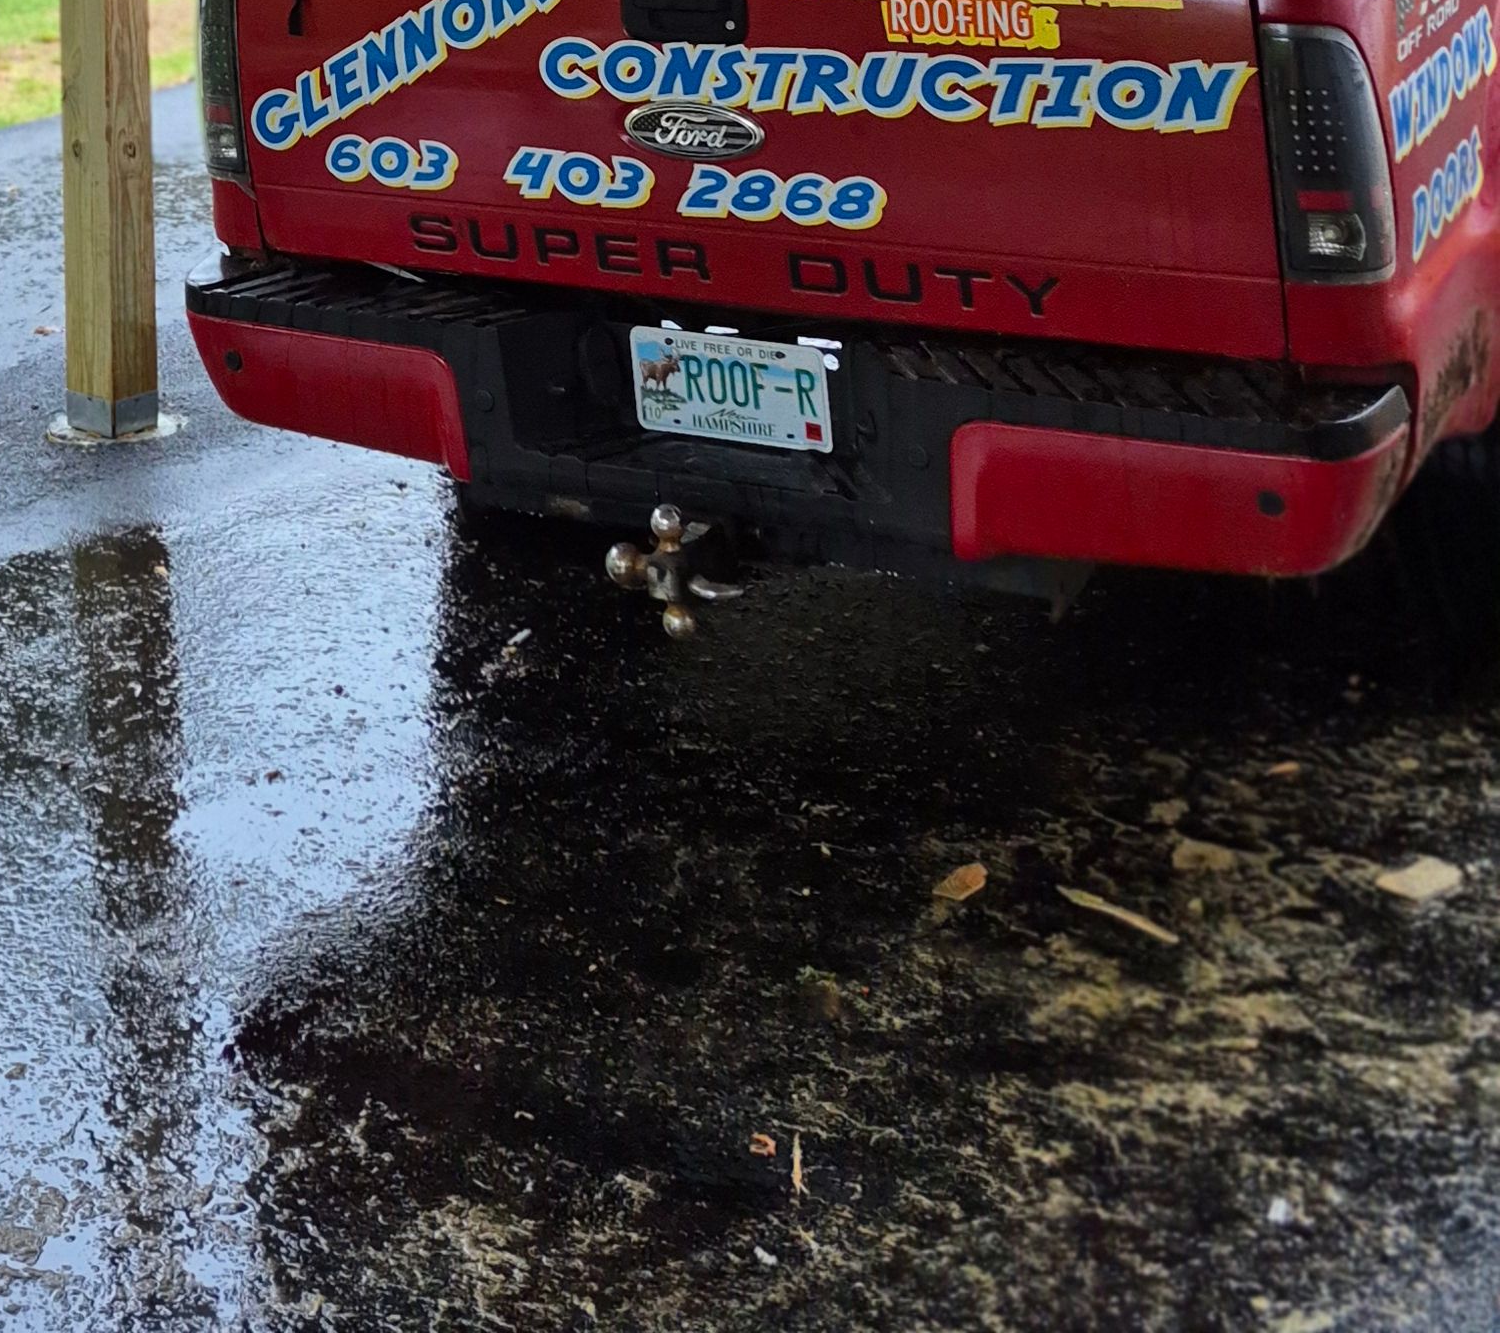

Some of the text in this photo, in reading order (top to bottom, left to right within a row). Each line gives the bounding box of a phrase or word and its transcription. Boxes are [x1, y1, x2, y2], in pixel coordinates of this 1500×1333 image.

[540, 37, 1254, 130] CONSTRUCTION
[1389, 6, 1496, 162] WINDOWS
[1397, 25, 1423, 62] OFF
[654, 112, 728, 148] Ford
[327, 135, 886, 228] 603 403 2868
[1413, 125, 1483, 263] DOORS
[408, 213, 1060, 318] SUPER DUTY
[674, 339, 777, 361] LIVE FREE OR DIE
[692, 413, 777, 438] HAMPSHIRE
